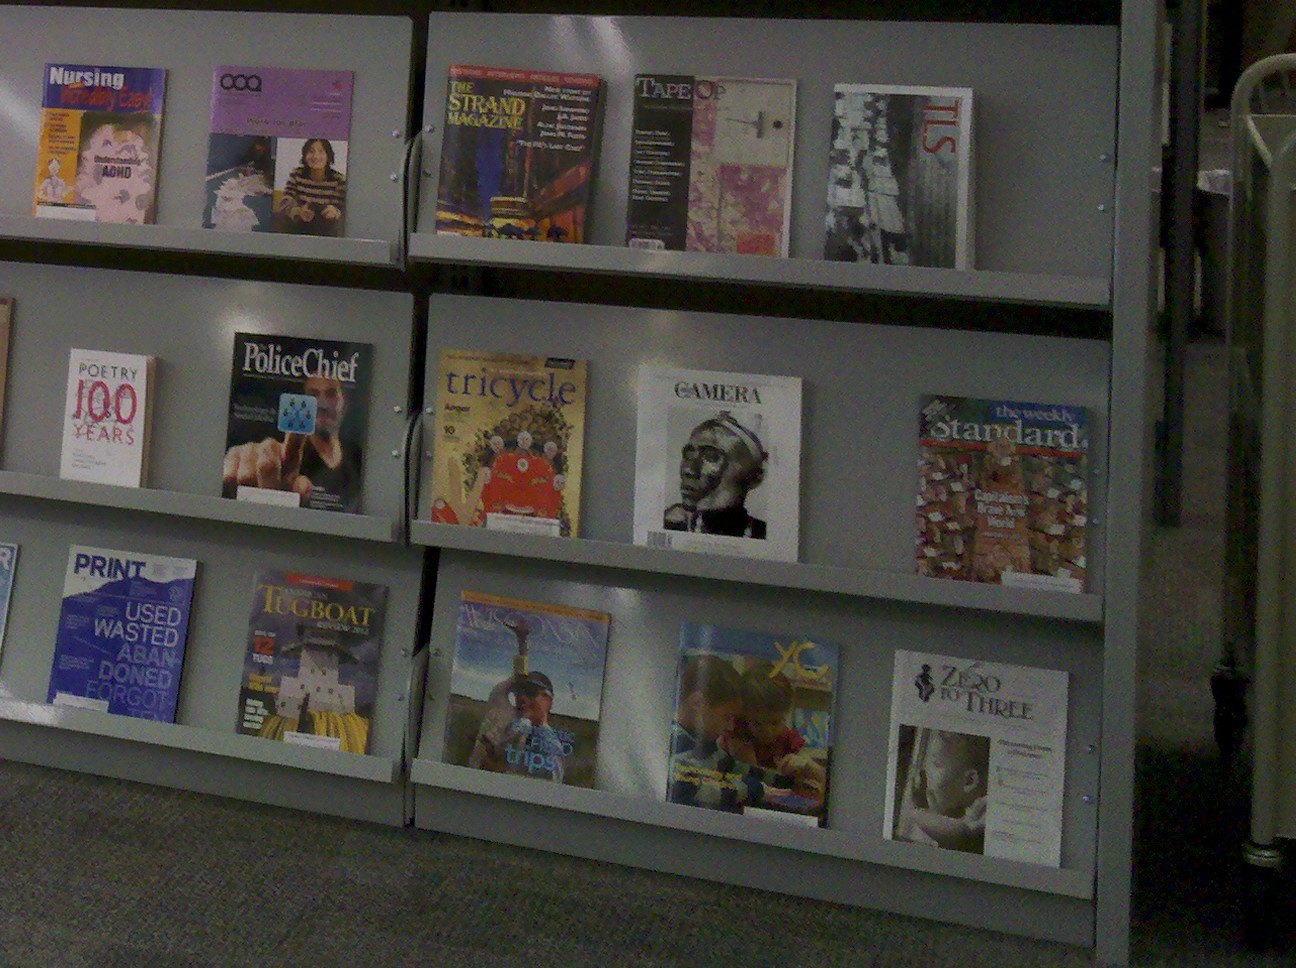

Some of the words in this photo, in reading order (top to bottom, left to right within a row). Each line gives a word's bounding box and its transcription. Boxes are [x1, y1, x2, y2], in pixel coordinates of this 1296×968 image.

[49, 66, 124, 90] Nursing
[449, 81, 474, 92] THE
[449, 92, 526, 117] STRAND
[447, 111, 524, 130] MAGAZINE
[923, 100, 960, 154] TLS
[101, 165, 132, 179] ADHD
[79, 362, 138, 381] POETRY
[446, 367, 577, 409] tricycle
[674, 381, 763, 406] CAMERA
[74, 379, 138, 425] 100
[73, 423, 136, 446] YEARS
[73, 552, 146, 579] PRINT
[125, 601, 182, 627] USED
[256, 584, 375, 626] TUGBOAT
[94, 617, 179, 648] WASTED
[116, 642, 178, 669] ABAN
[98, 660, 172, 690] DONED
[504, 744, 558, 775] trips
